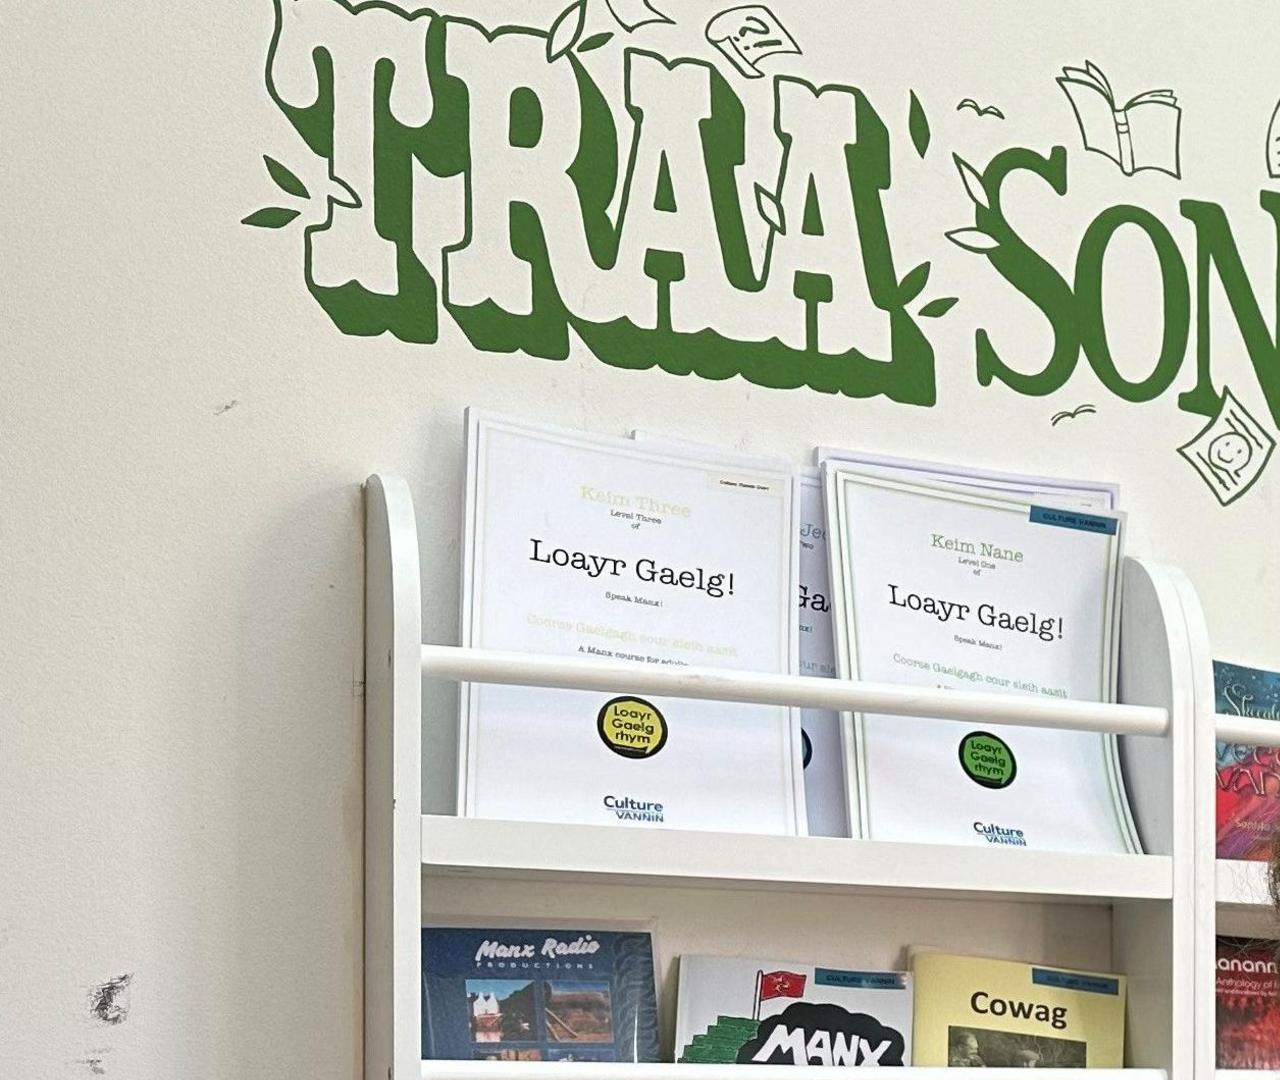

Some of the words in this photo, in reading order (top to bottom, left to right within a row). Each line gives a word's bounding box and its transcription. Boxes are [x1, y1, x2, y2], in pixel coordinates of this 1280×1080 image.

[635, 495, 692, 518] Three
[931, 533, 976, 554] Keim
[980, 542, 1024, 563] Nane
[529, 538, 626, 578] Loayr
[636, 558, 734, 597] Gaelg!
[888, 584, 970, 622] Loayr
[977, 603, 1063, 642] Gaelg!
[893, 653, 931, 671] Coorse
[614, 706, 651, 720] Loayr
[612, 718, 654, 735] Gaelg
[615, 731, 650, 743] rhym
[970, 741, 1002, 755] Loayr
[971, 752, 1006, 768] Gaelg
[974, 763, 1004, 775] rhym
[603, 795, 663, 812] Culture
[973, 821, 1024, 838] Culture
[475, 940, 535, 960] Manx
[541, 934, 600, 959] Radio
[970, 991, 1068, 1030] Cowag
[752, 1024, 891, 1066] MANX
